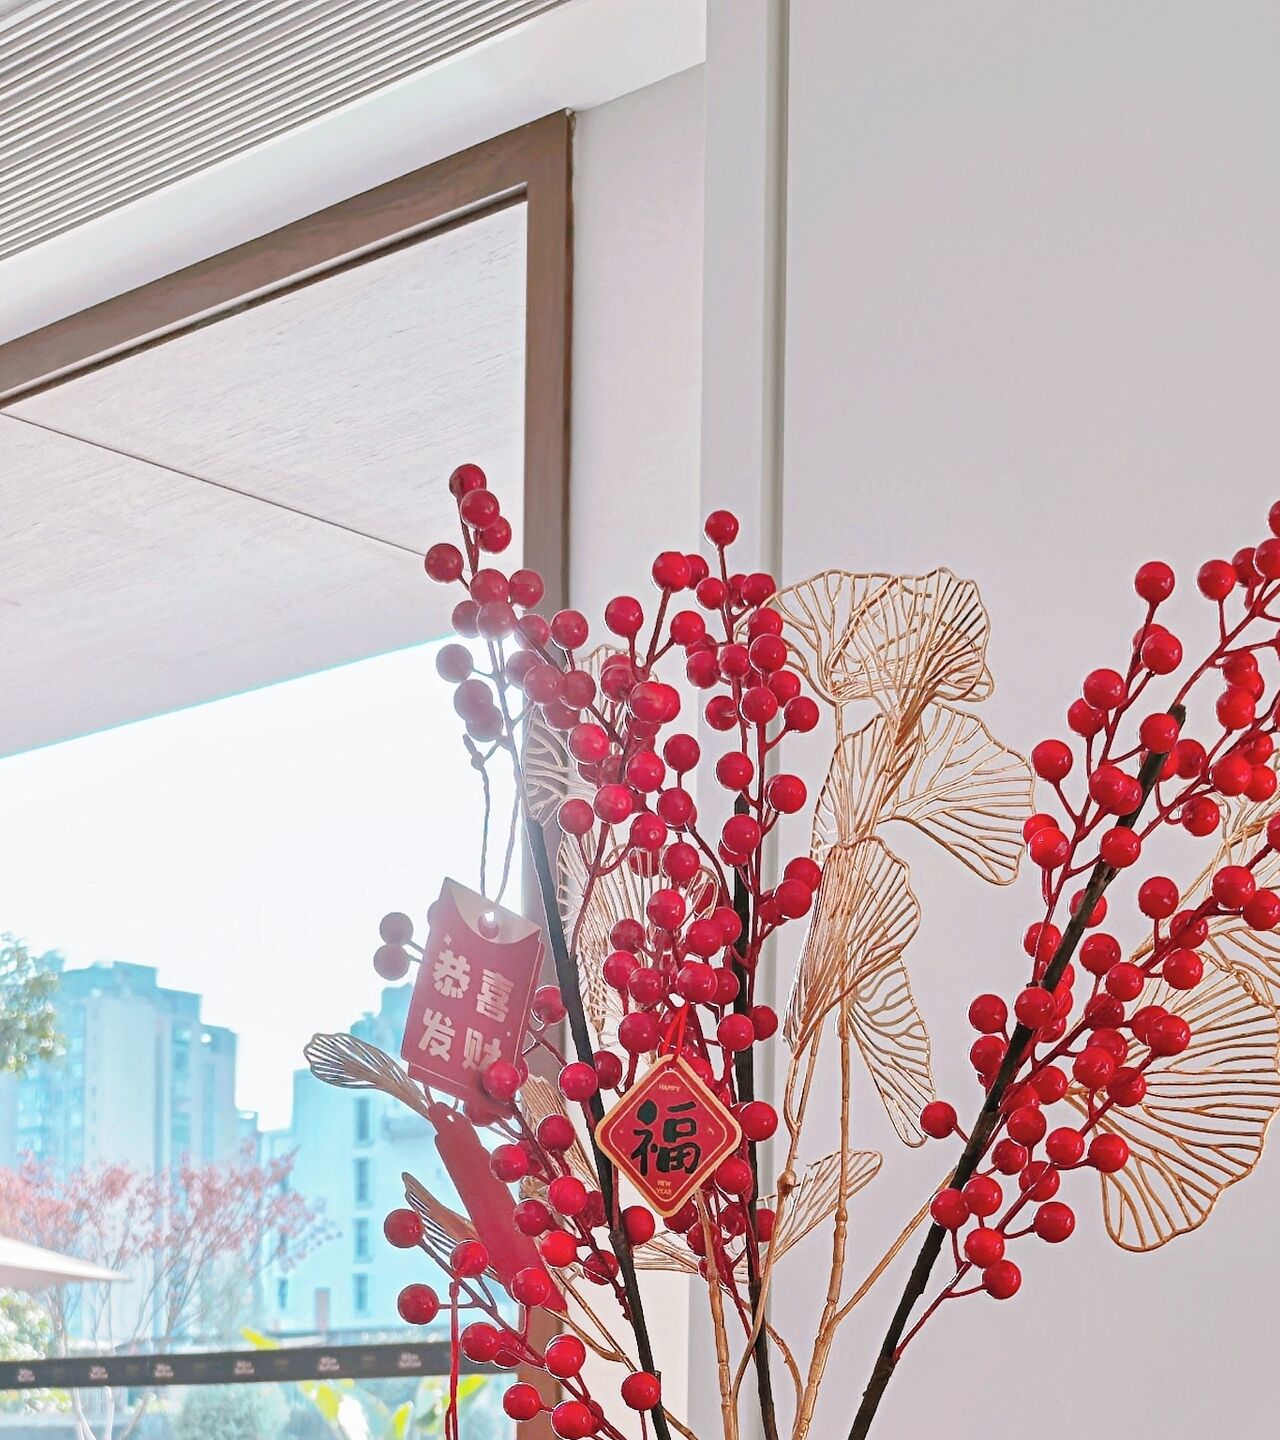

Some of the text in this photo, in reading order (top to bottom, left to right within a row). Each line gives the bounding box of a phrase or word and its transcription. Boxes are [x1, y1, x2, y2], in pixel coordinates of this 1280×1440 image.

[434, 948, 516, 1024] 恭喜
[418, 1007, 502, 1072] 发财
[631, 1099, 702, 1177] 福
